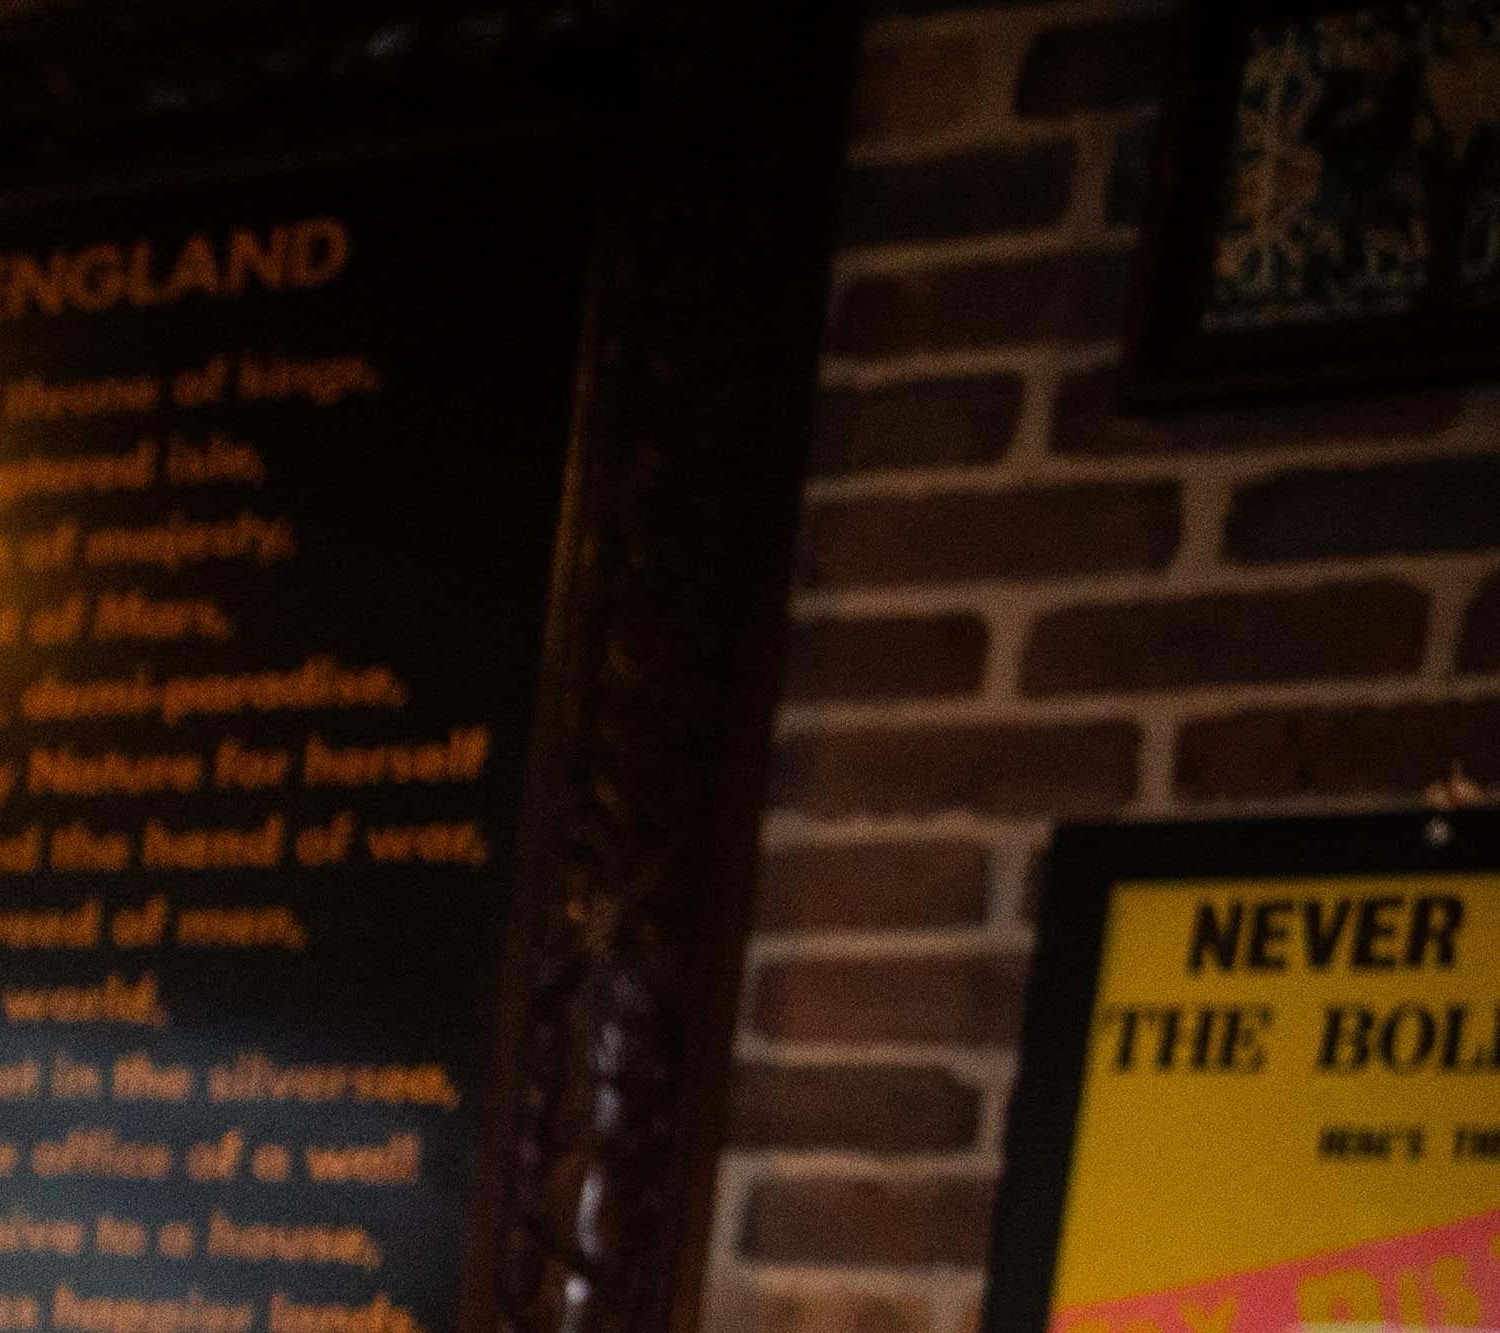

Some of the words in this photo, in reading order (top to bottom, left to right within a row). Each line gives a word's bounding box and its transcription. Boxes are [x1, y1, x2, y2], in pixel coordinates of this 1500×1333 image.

[7, 377, 158, 419] throne
[175, 358, 229, 406] of
[23, 522, 78, 570] of
[31, 597, 85, 644] of
[23, 659, 408, 721] demi-paradise,
[29, 748, 203, 794] Nature
[215, 740, 290, 788] for
[304, 726, 491, 785] herself
[51, 824, 131, 871] the
[143, 816, 285, 869] hand
[296, 813, 354, 866] of
[368, 822, 489, 866] war,
[113, 897, 168, 948] of
[1187, 893, 1465, 977] NEVER
[5, 975, 170, 1026] world,
[1100, 1004, 1272, 1075] THE
[51, 1054, 101, 1099] in
[112, 1052, 193, 1101] the
[32, 1126, 173, 1179] office
[187, 1127, 244, 1181] of
[252, 1144, 291, 1182] a
[306, 1132, 422, 1183] wall
[95, 1214, 147, 1258] to
[158, 1222, 194, 1259] a
[207, 1212, 382, 1268] house,
